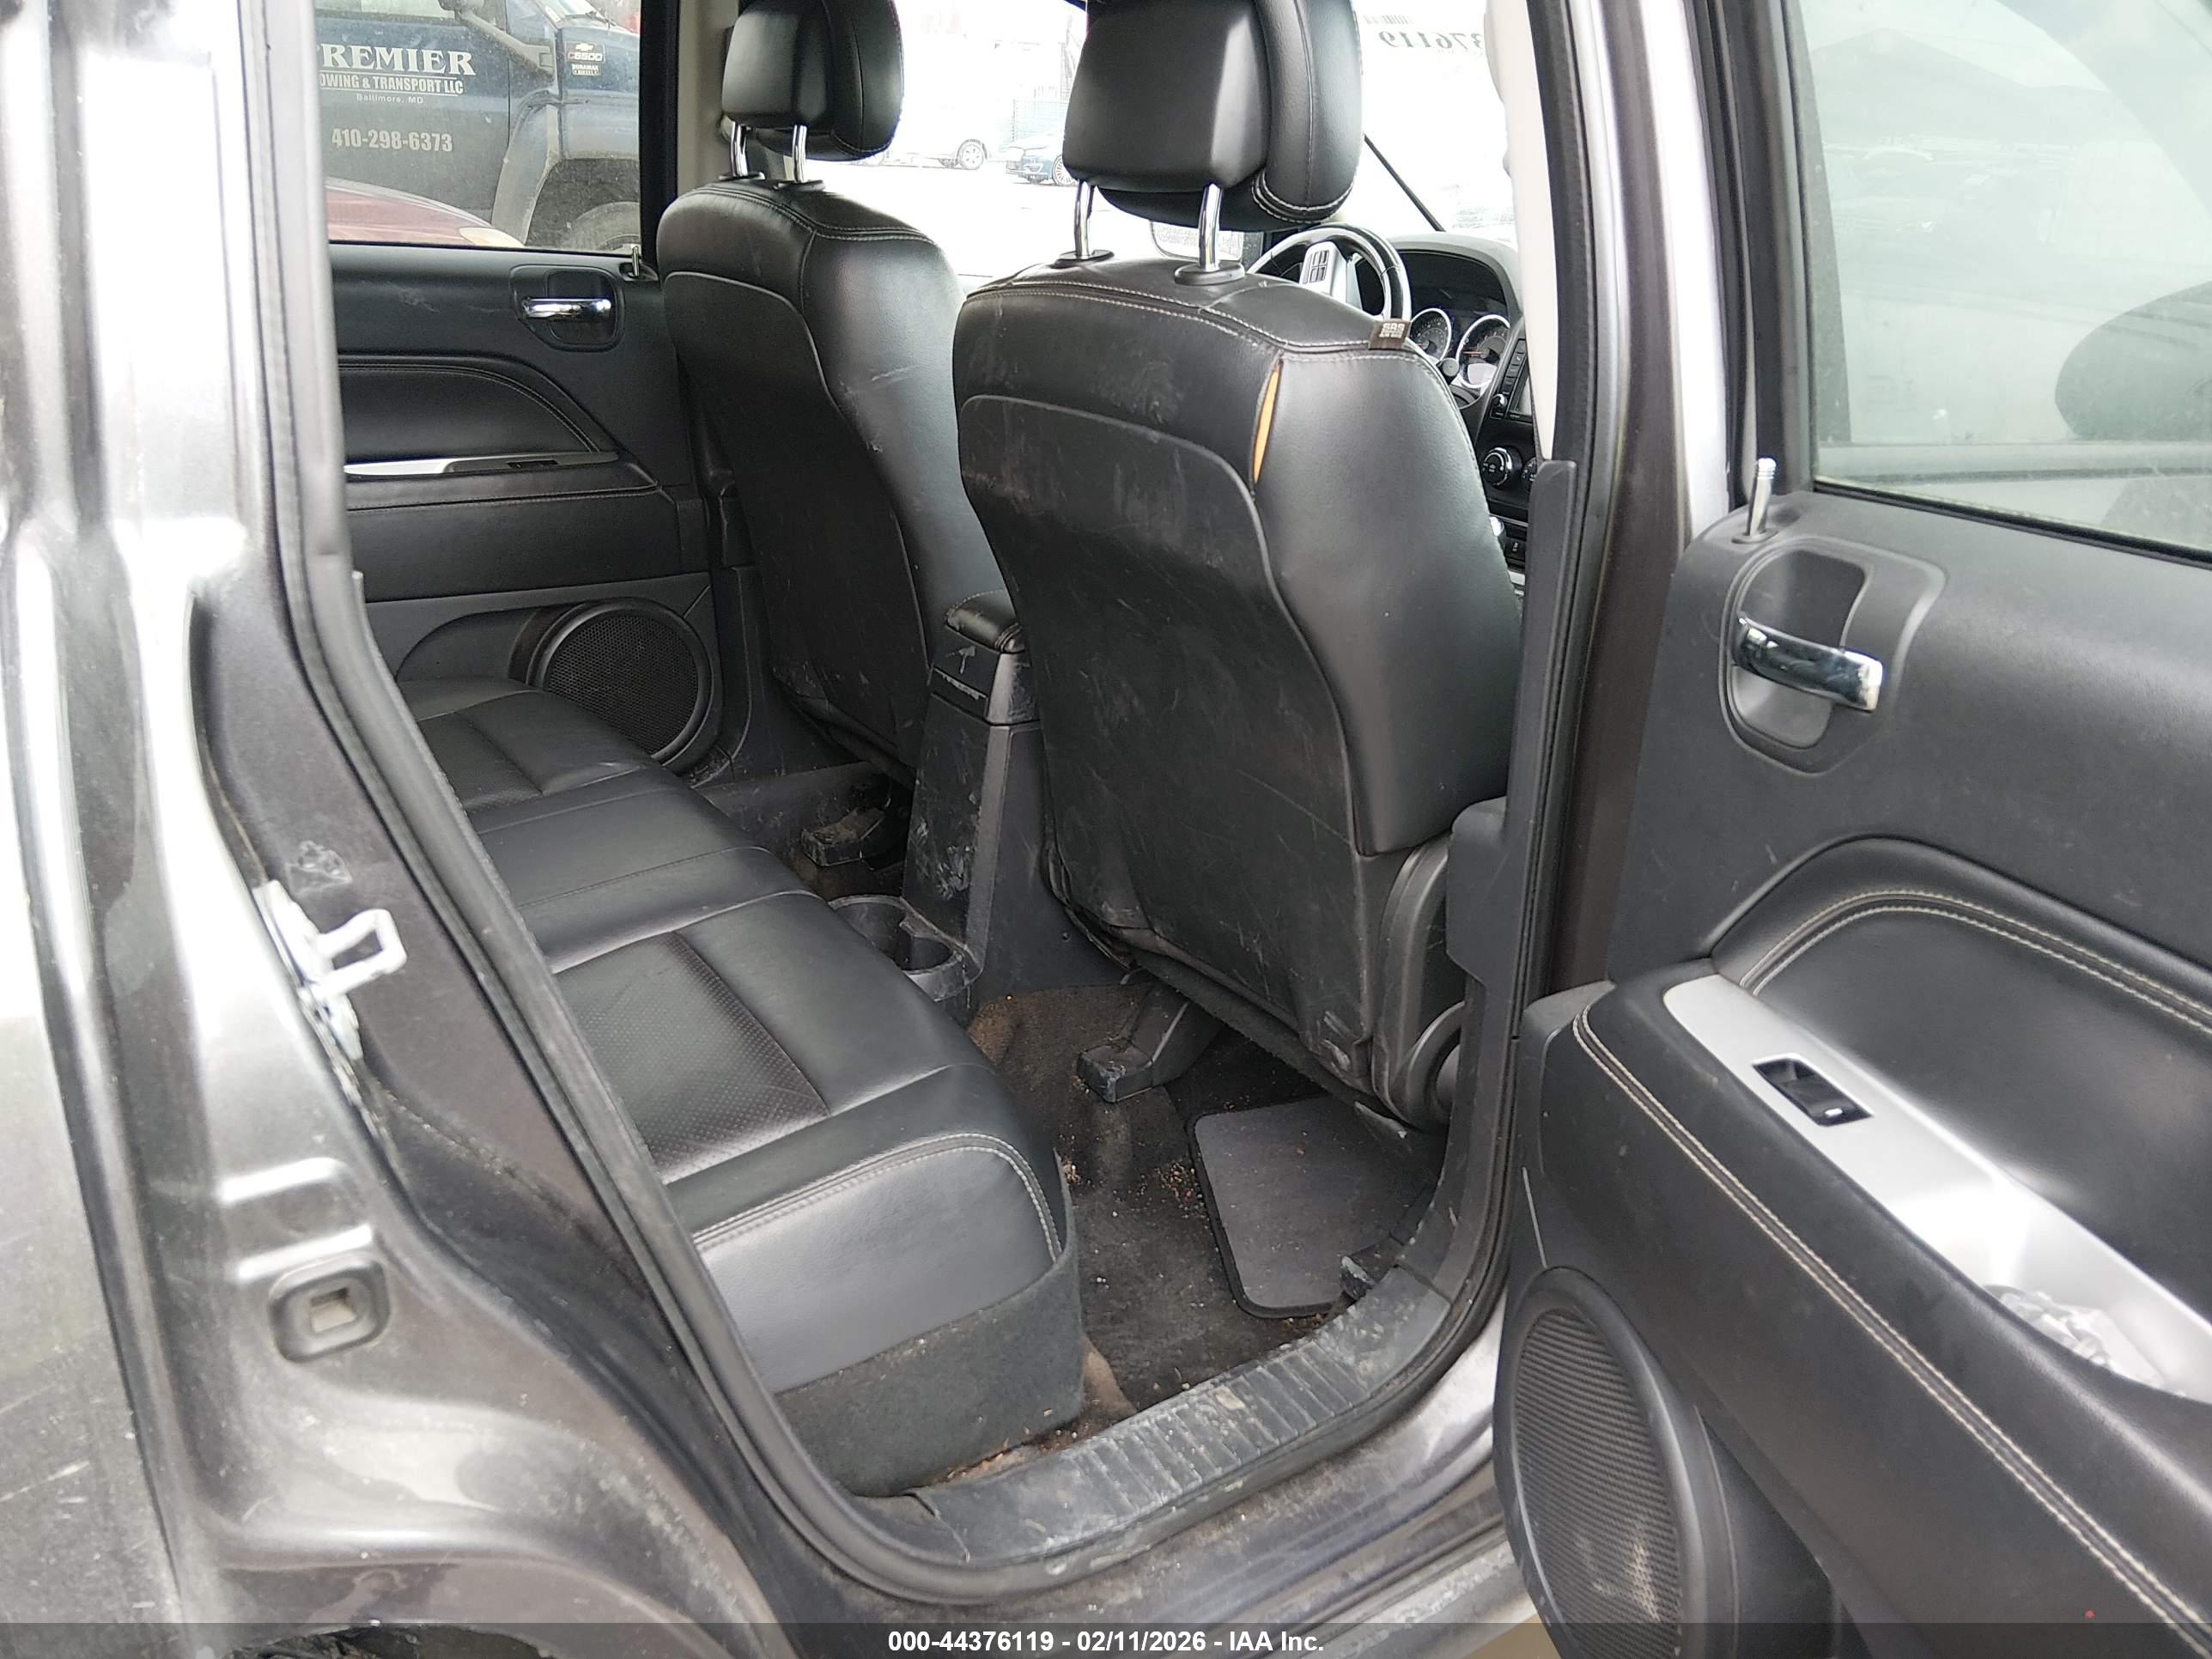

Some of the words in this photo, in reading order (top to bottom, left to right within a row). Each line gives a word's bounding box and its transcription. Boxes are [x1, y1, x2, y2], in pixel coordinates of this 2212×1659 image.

[317, 44, 476, 76] REMIER
[319, 73, 360, 88] OWING
[362, 78, 371, 88] &
[373, 76, 441, 92] TRANSPORT
[444, 80, 465, 94] LLC
[356, 94, 404, 104] Baltimore,
[331, 128, 453, 152] 410-298-6373
